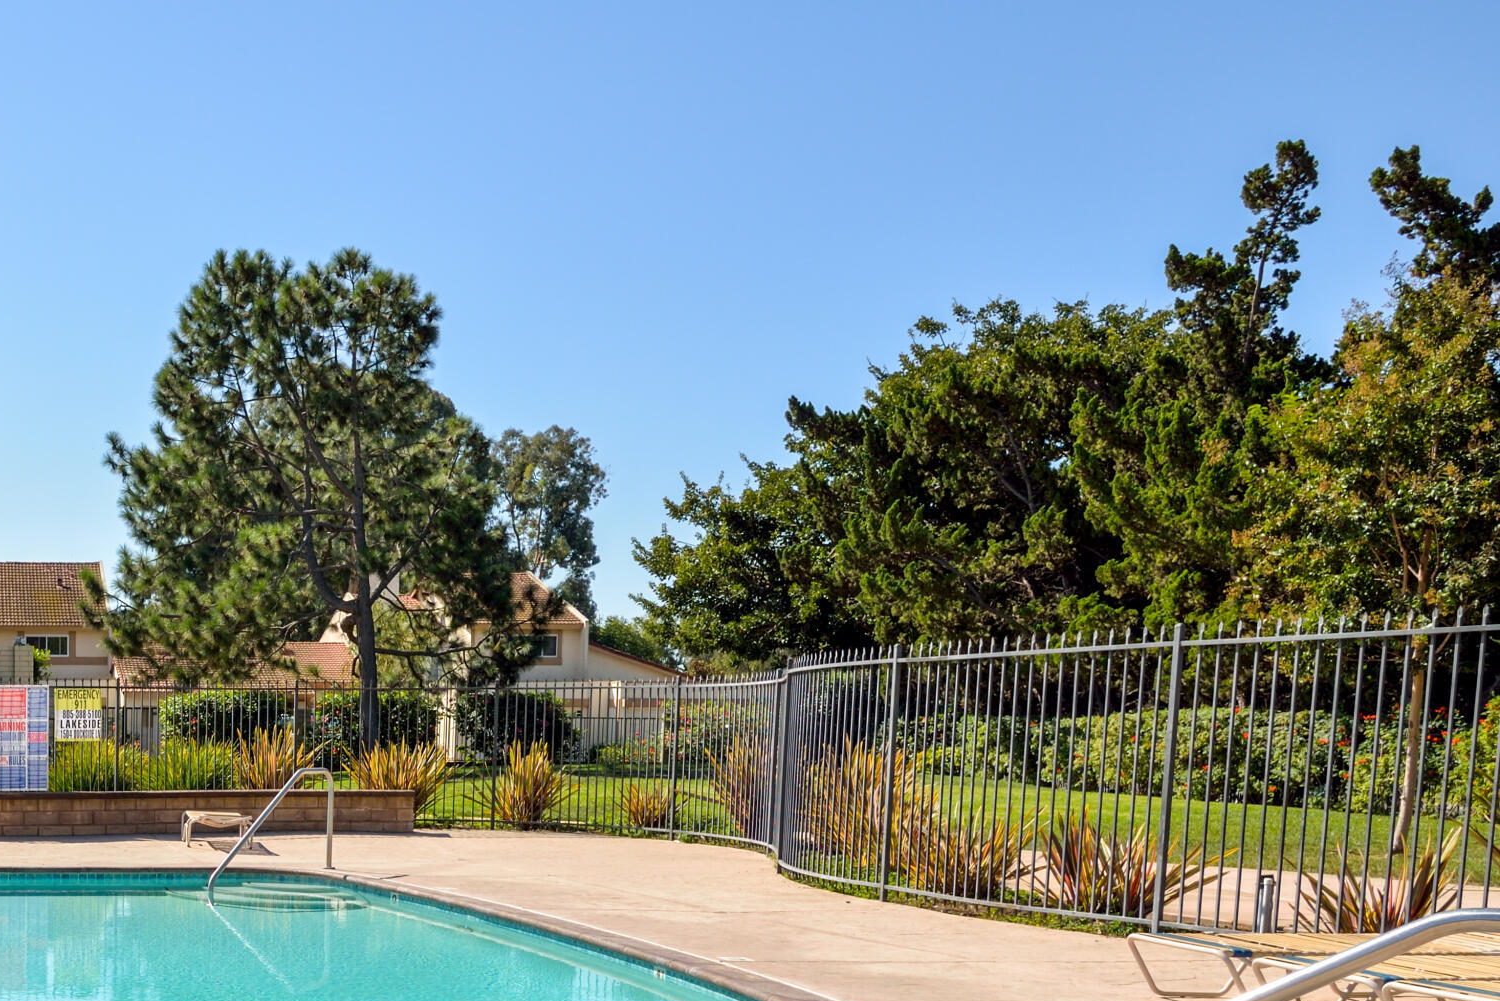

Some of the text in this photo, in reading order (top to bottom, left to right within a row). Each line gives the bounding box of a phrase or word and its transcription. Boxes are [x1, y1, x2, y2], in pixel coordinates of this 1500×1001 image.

[57, 690, 100, 699] EMERGENCY
[74, 700, 87, 709] 911
[60, 720, 101, 728] LAKESIDE
[8, 756, 26, 765] RULES
